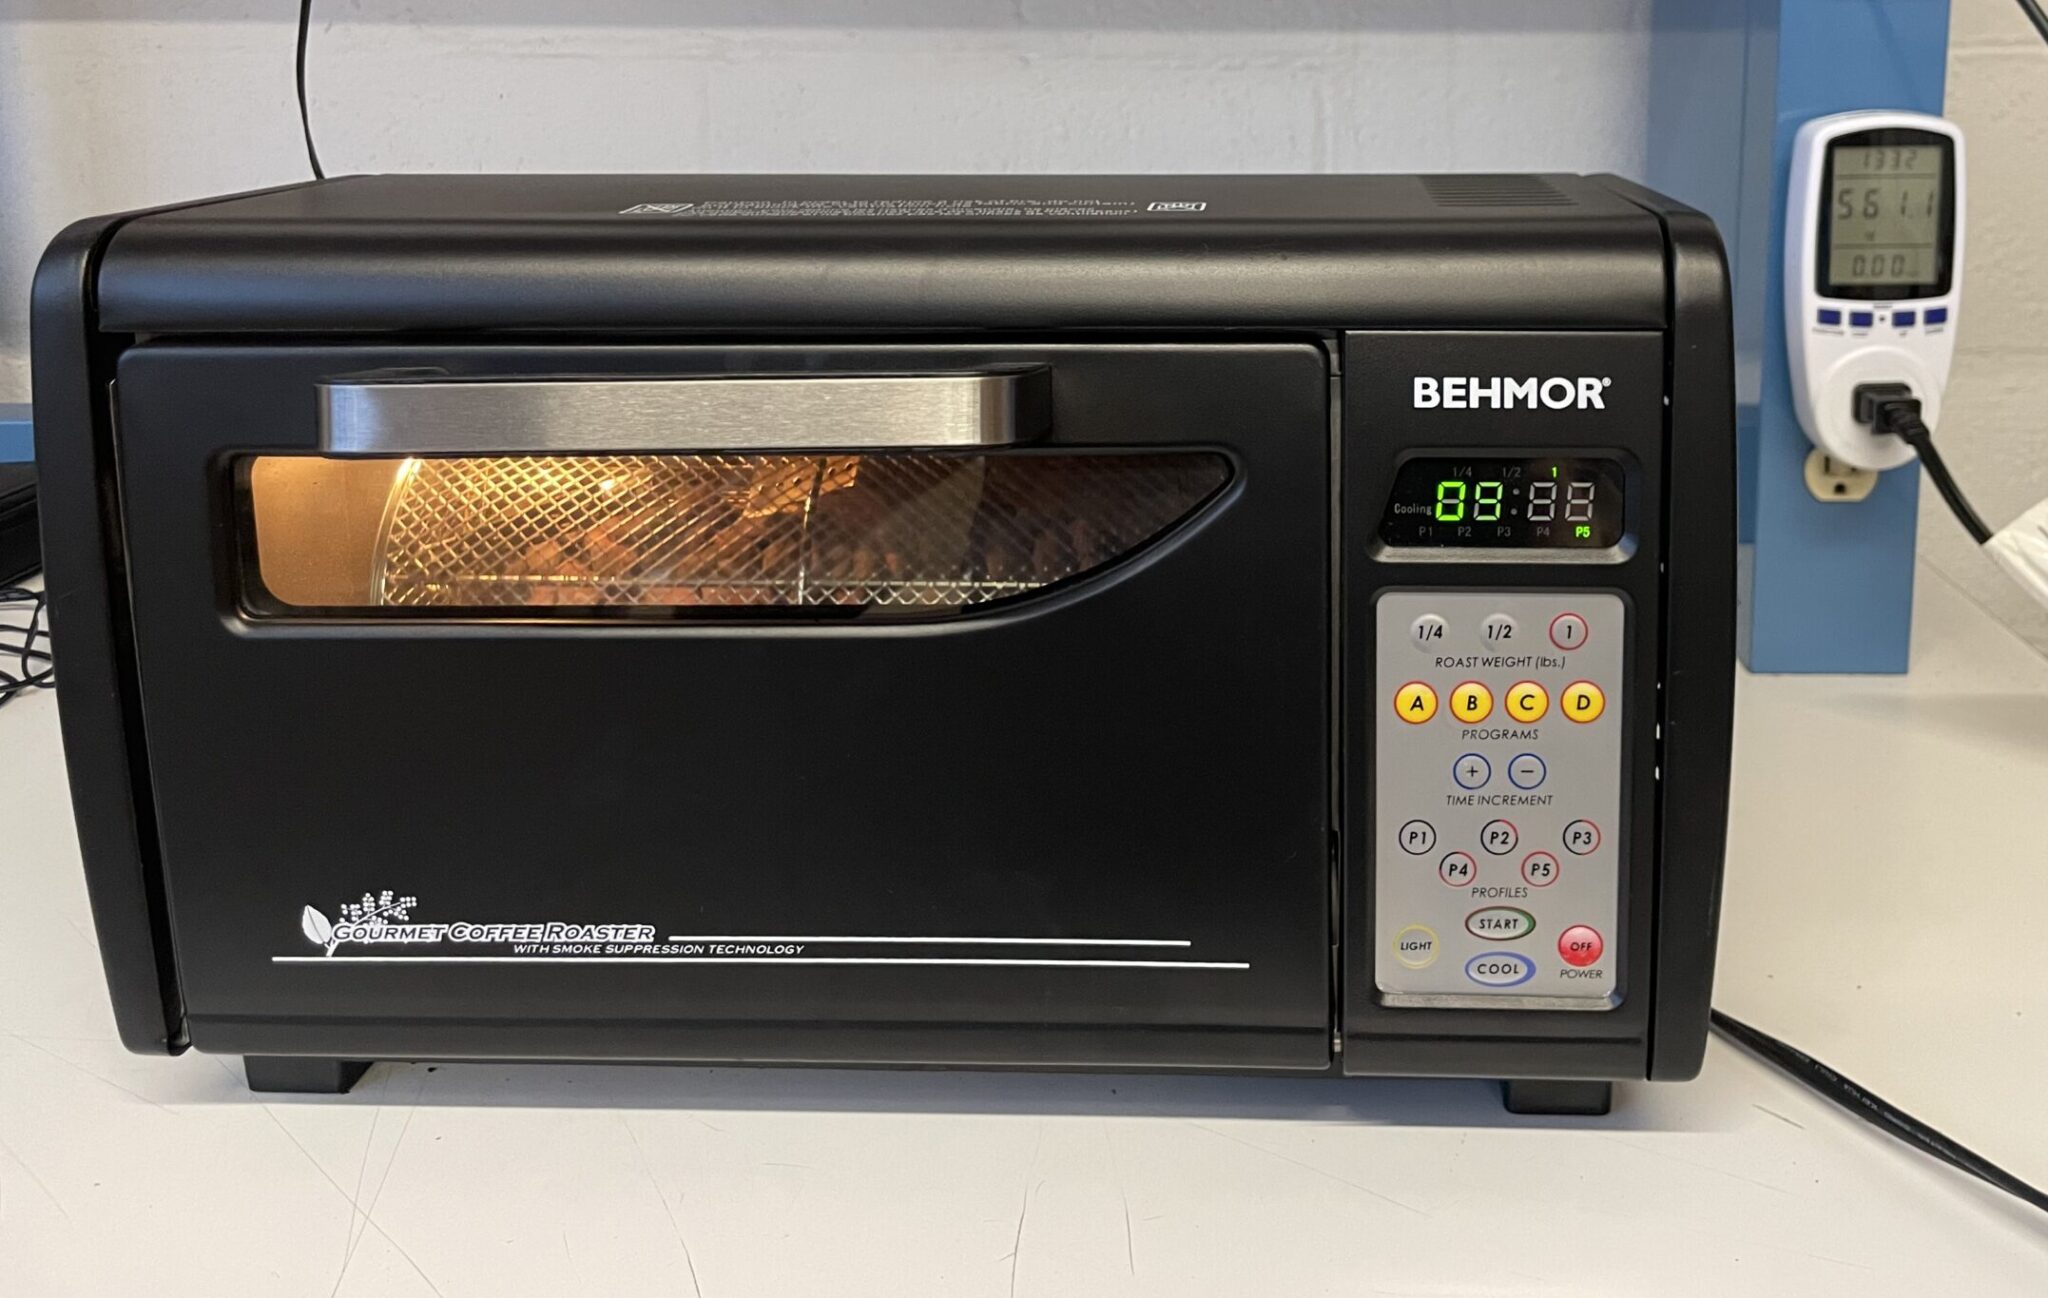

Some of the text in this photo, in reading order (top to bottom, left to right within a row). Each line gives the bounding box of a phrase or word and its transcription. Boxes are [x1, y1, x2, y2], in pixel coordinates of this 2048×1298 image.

[1453, 466, 1558, 478] 1/4 1/2 1
[1394, 503, 1432, 516] Cooling
[1419, 526, 1591, 538] P1 P2 P3 P4 P5
[1418, 624, 1573, 640] 1/4 1/2 1
[1435, 656, 1566, 669] ROAST WEIGHT (lbs.)
[1410, 694, 1591, 711] A B C D
[1461, 729, 1539, 740] PROGRAMS
[1446, 794, 1554, 806] TIME INCREMENT
[1409, 831, 1593, 845] P1 P2 P3
[1448, 863, 1551, 877] P4 P5
[1471, 887, 1529, 898] PROFILES
[1478, 918, 1519, 930] START
[333, 921, 656, 943] GOURMET COFFEE ROASTER
[514, 944, 805, 955] WITH SMOKE SUPPRESSION TECHNOLOGY
[1400, 941, 1432, 951] LIGHT
[1570, 941, 1593, 952] OFF
[1477, 963, 1520, 975] COOL
[1559, 969, 1603, 979] POWER
